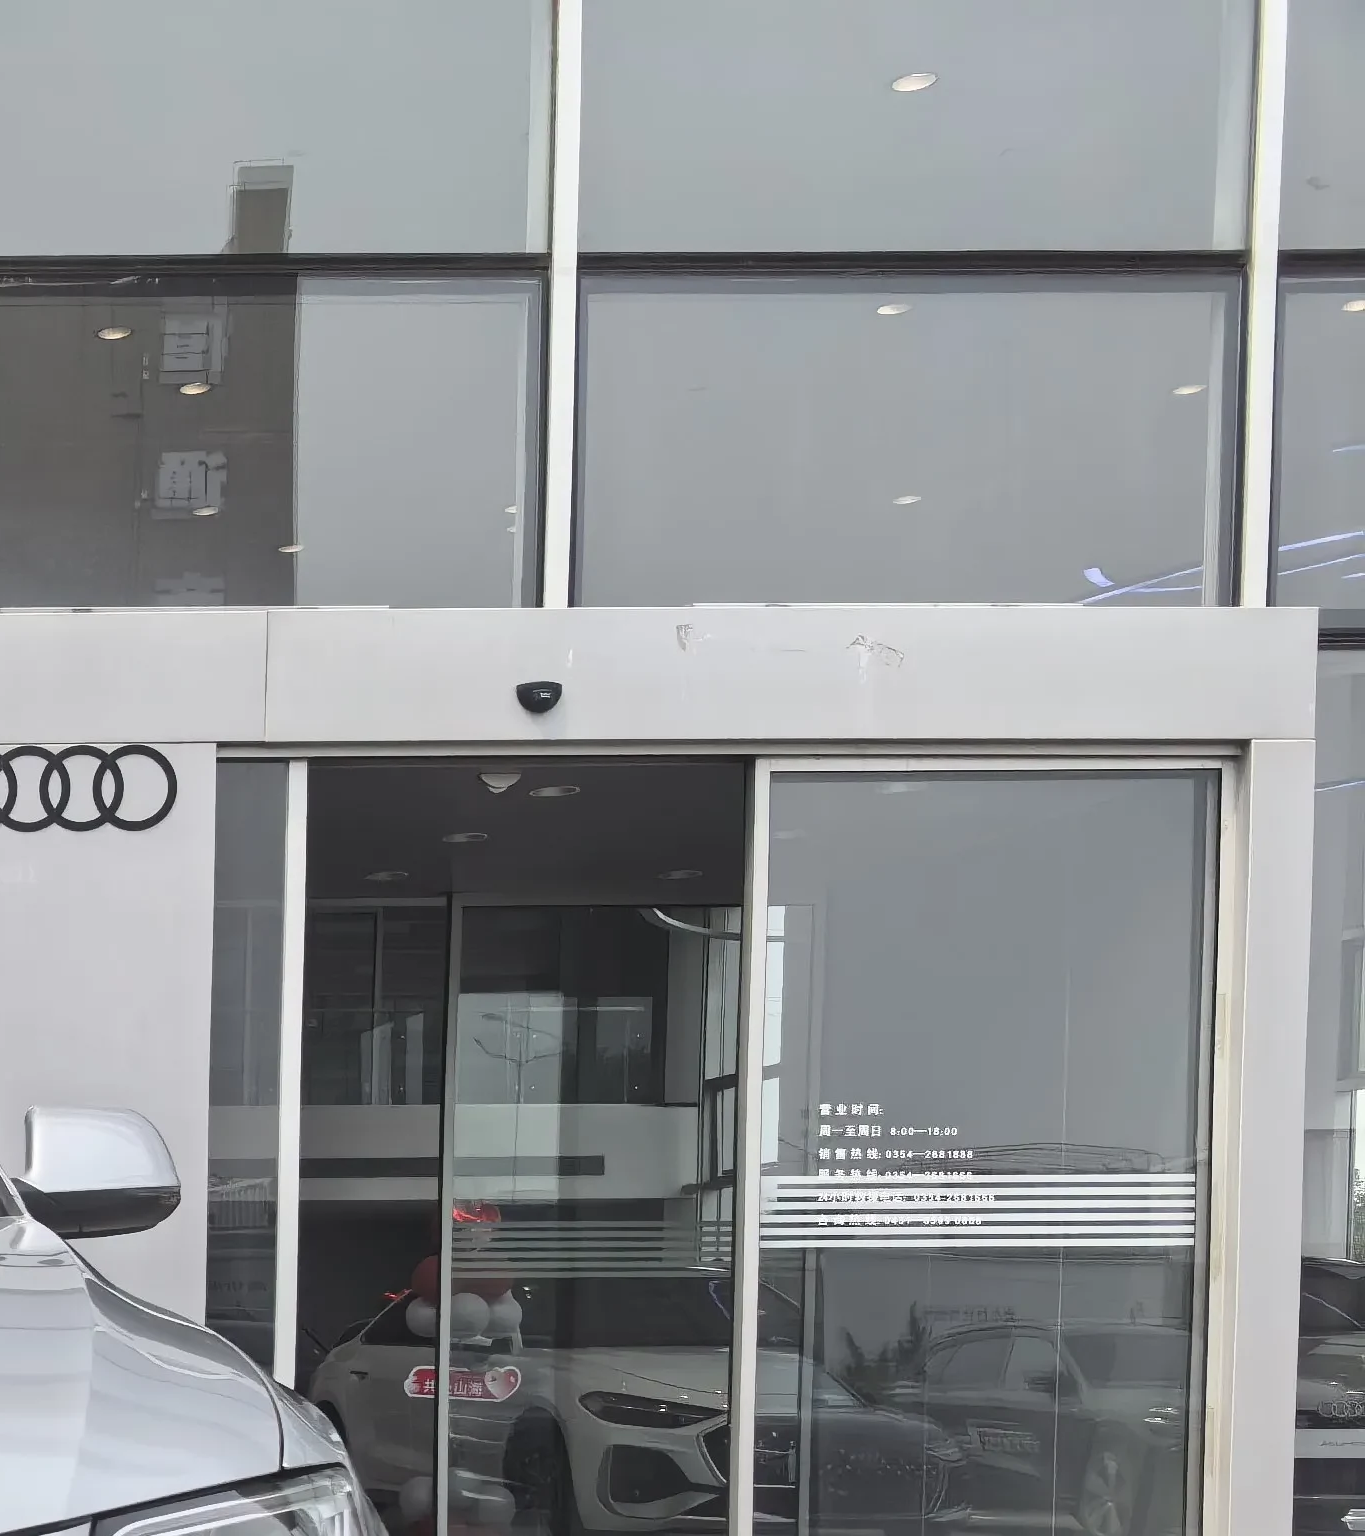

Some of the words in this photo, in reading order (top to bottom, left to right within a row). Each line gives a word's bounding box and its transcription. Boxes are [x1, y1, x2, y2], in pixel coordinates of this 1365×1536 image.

[818, 1124, 882, 1137] 周一至周日
